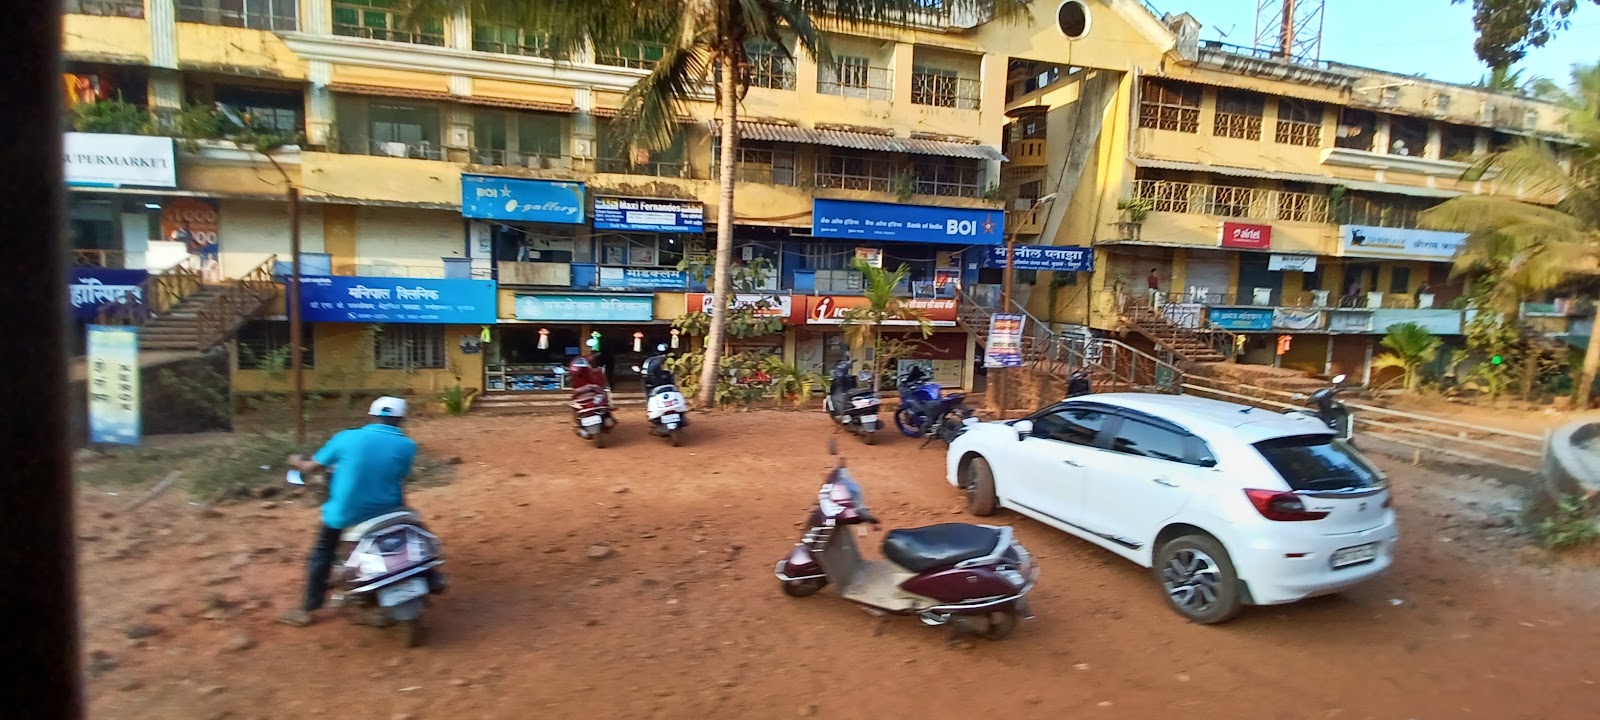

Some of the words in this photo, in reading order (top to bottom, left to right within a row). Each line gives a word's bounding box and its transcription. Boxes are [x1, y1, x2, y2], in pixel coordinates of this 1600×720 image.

[476, 187, 498, 198] BOI
[620, 199, 639, 211] Maxi
[640, 201, 681, 213] Fernandes
[906, 221, 921, 229] Bank
[946, 219, 977, 237] BOI
[1240, 227, 1260, 240] airtel
[1044, 248, 1084, 261] प्लाझा
[347, 285, 391, 300] मनिपाल
